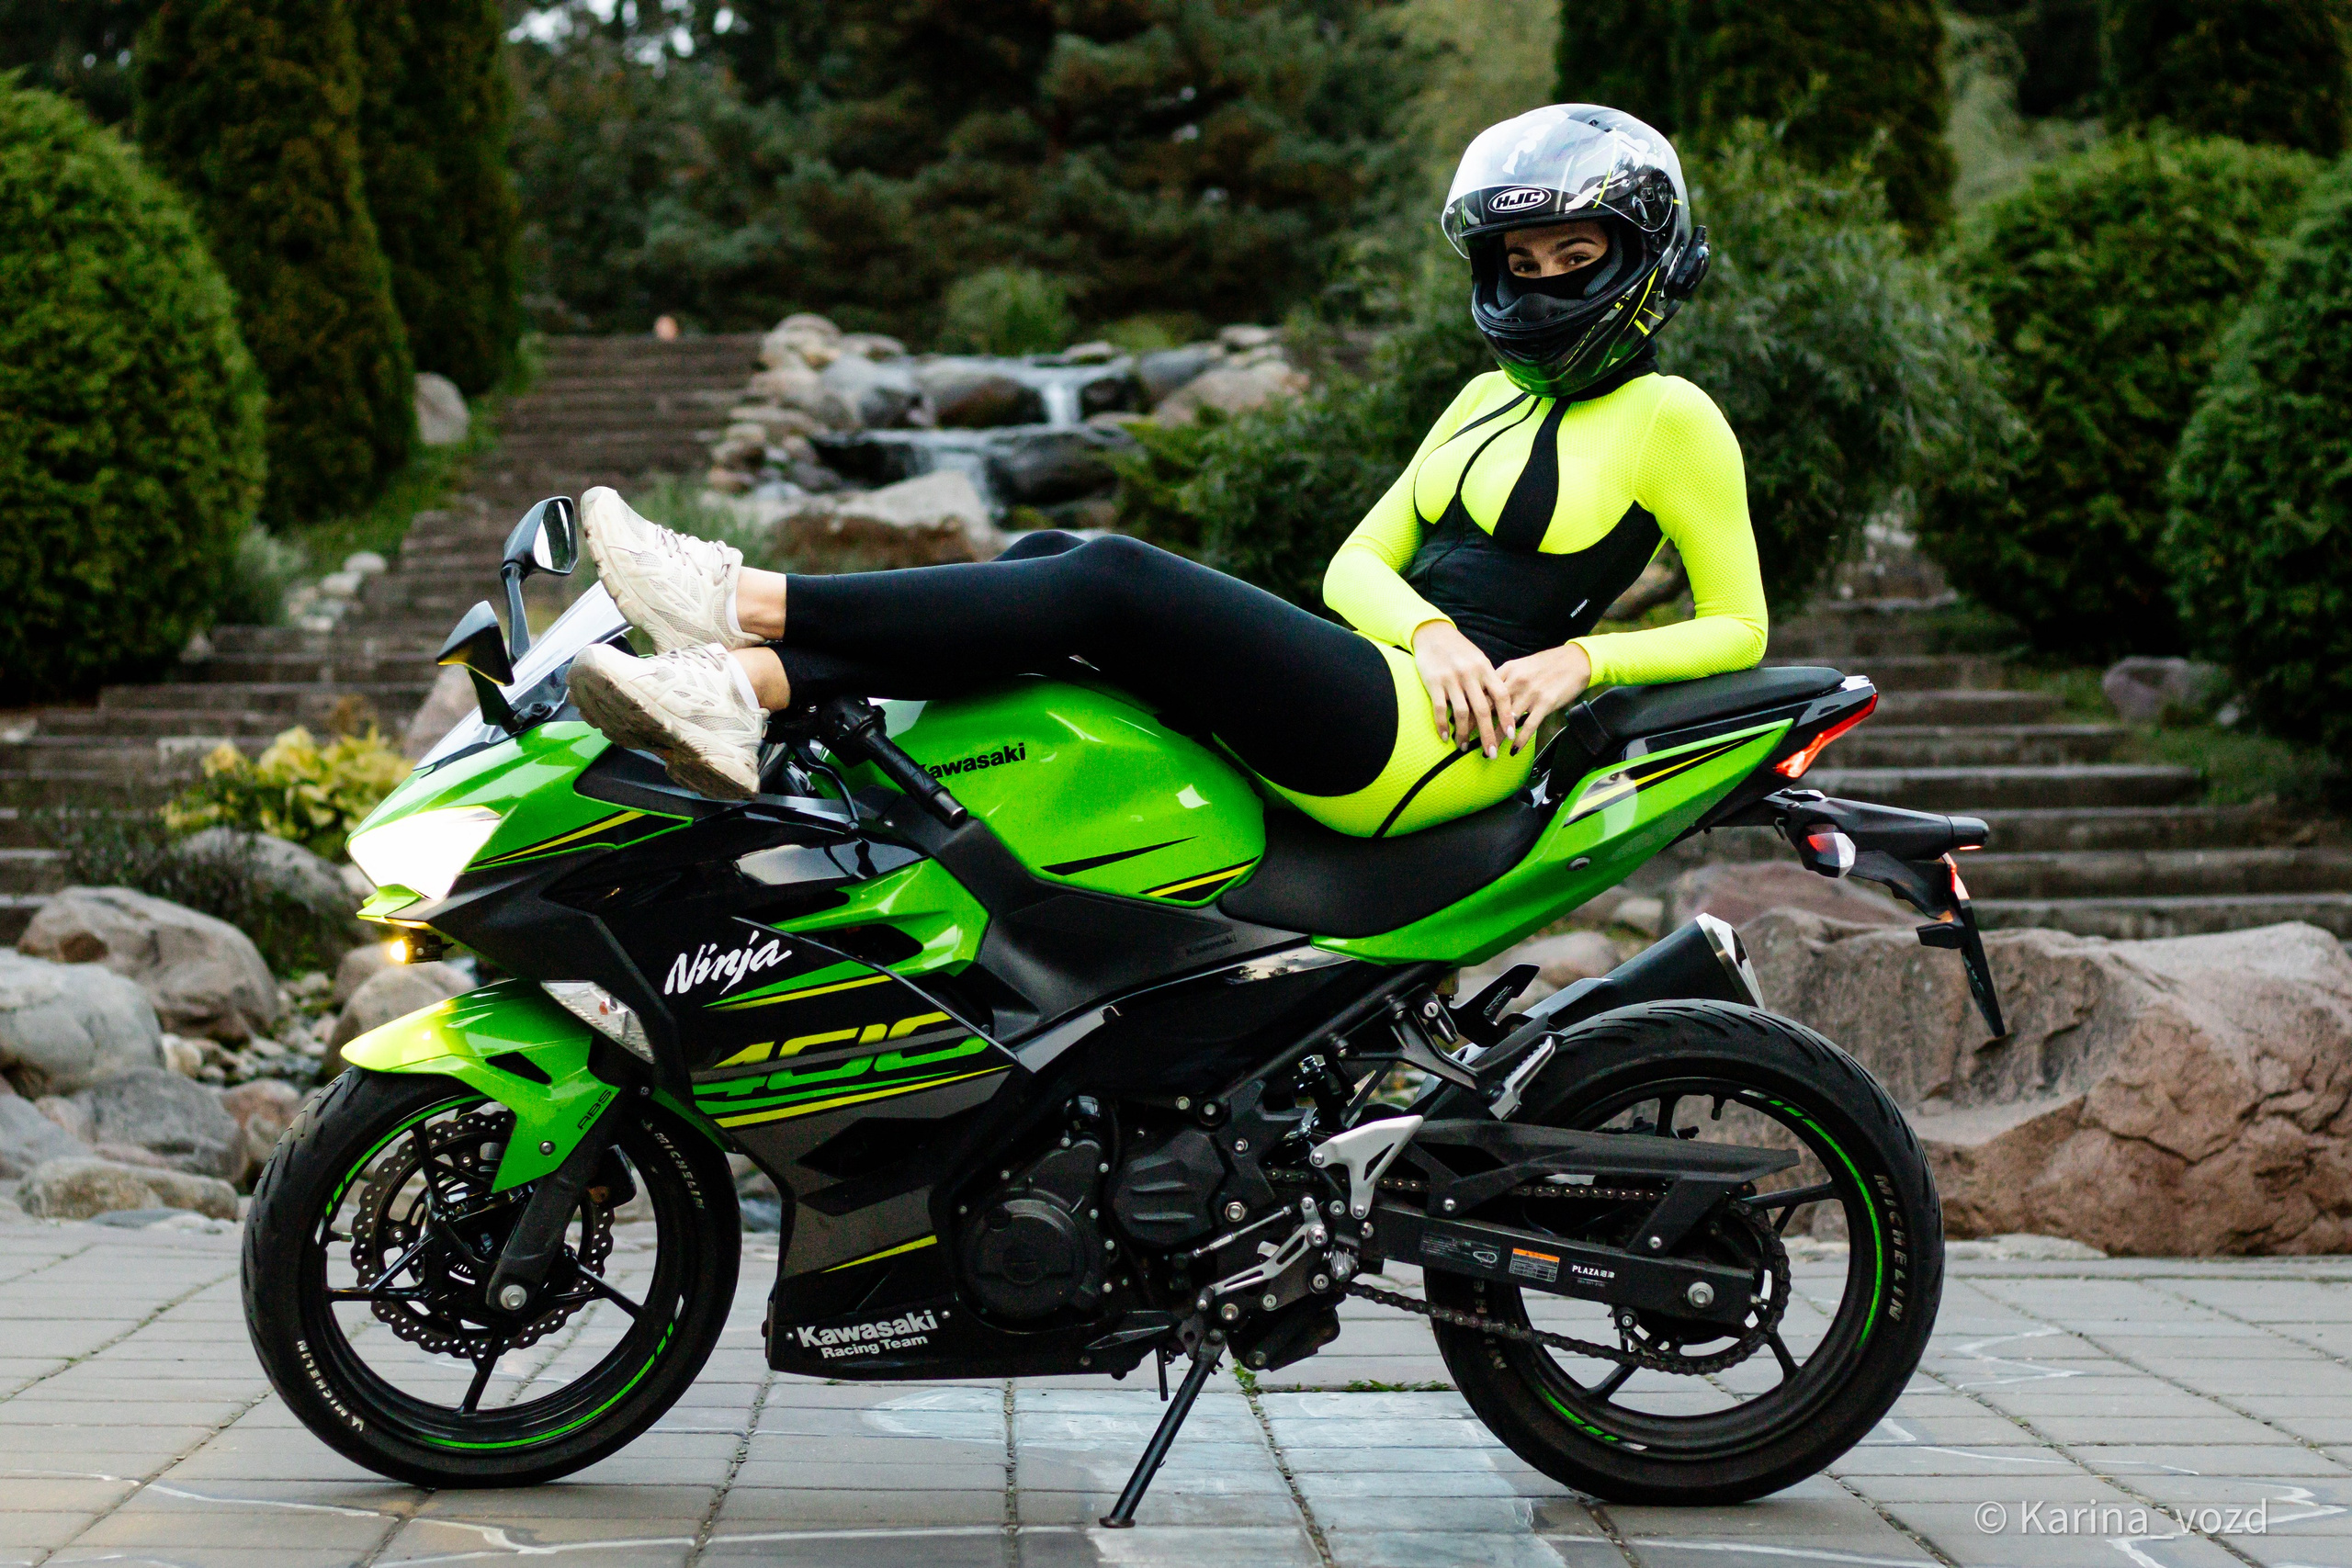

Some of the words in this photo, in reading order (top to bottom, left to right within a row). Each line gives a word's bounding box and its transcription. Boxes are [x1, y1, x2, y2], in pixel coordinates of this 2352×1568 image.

[1496, 191, 1542, 209] HJC
[920, 742, 1026, 779] awasaki
[664, 930, 793, 996] Ninja
[577, 1089, 612, 1131] ABS
[1873, 1174, 1907, 1323] MICHELIN
[797, 1309, 939, 1348] Kawasaki
[820, 1342, 880, 1359] Racing
[879, 1335, 929, 1351] Team
[296, 1339, 349, 1417] MICHELIN
